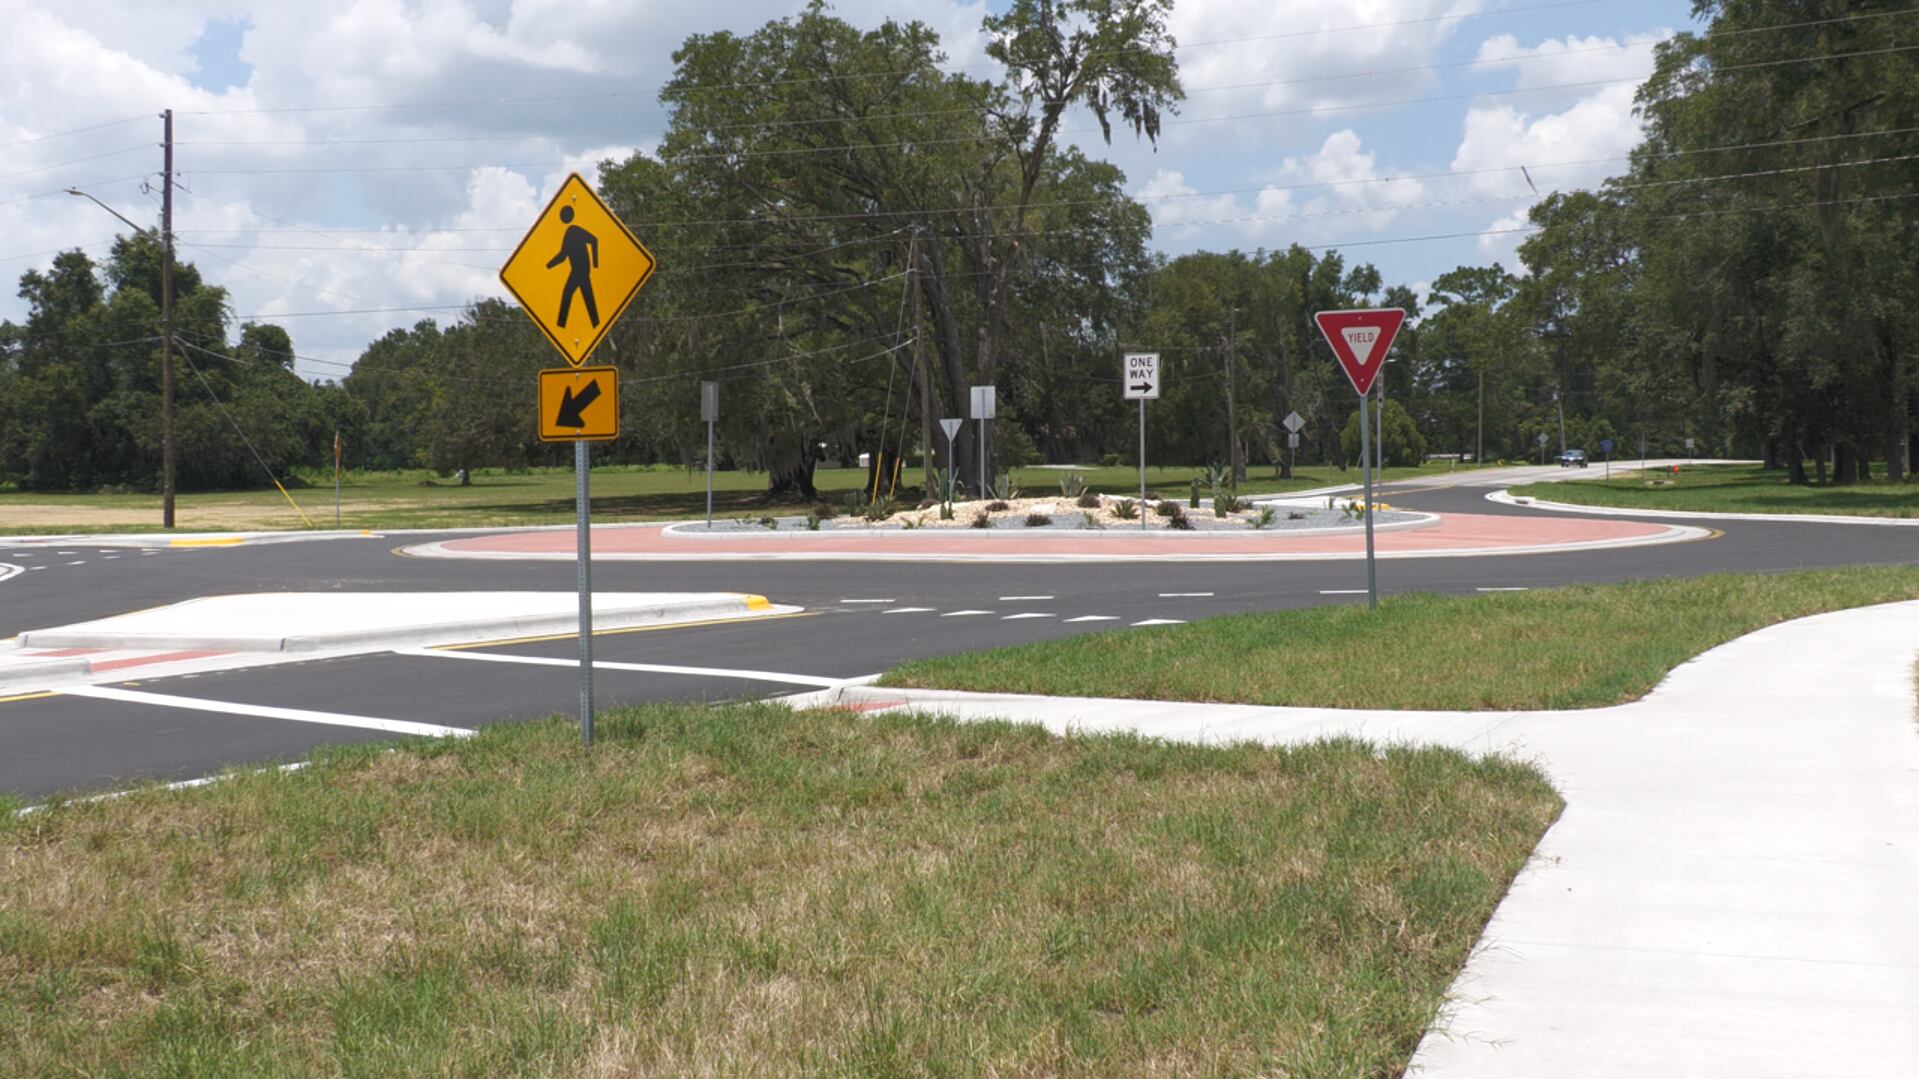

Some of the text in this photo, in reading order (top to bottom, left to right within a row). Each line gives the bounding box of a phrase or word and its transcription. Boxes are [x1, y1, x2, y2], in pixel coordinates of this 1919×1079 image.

[1348, 332, 1375, 343] YIELD
[1130, 357, 1153, 368] ONE
[1129, 368, 1154, 379] WAY
